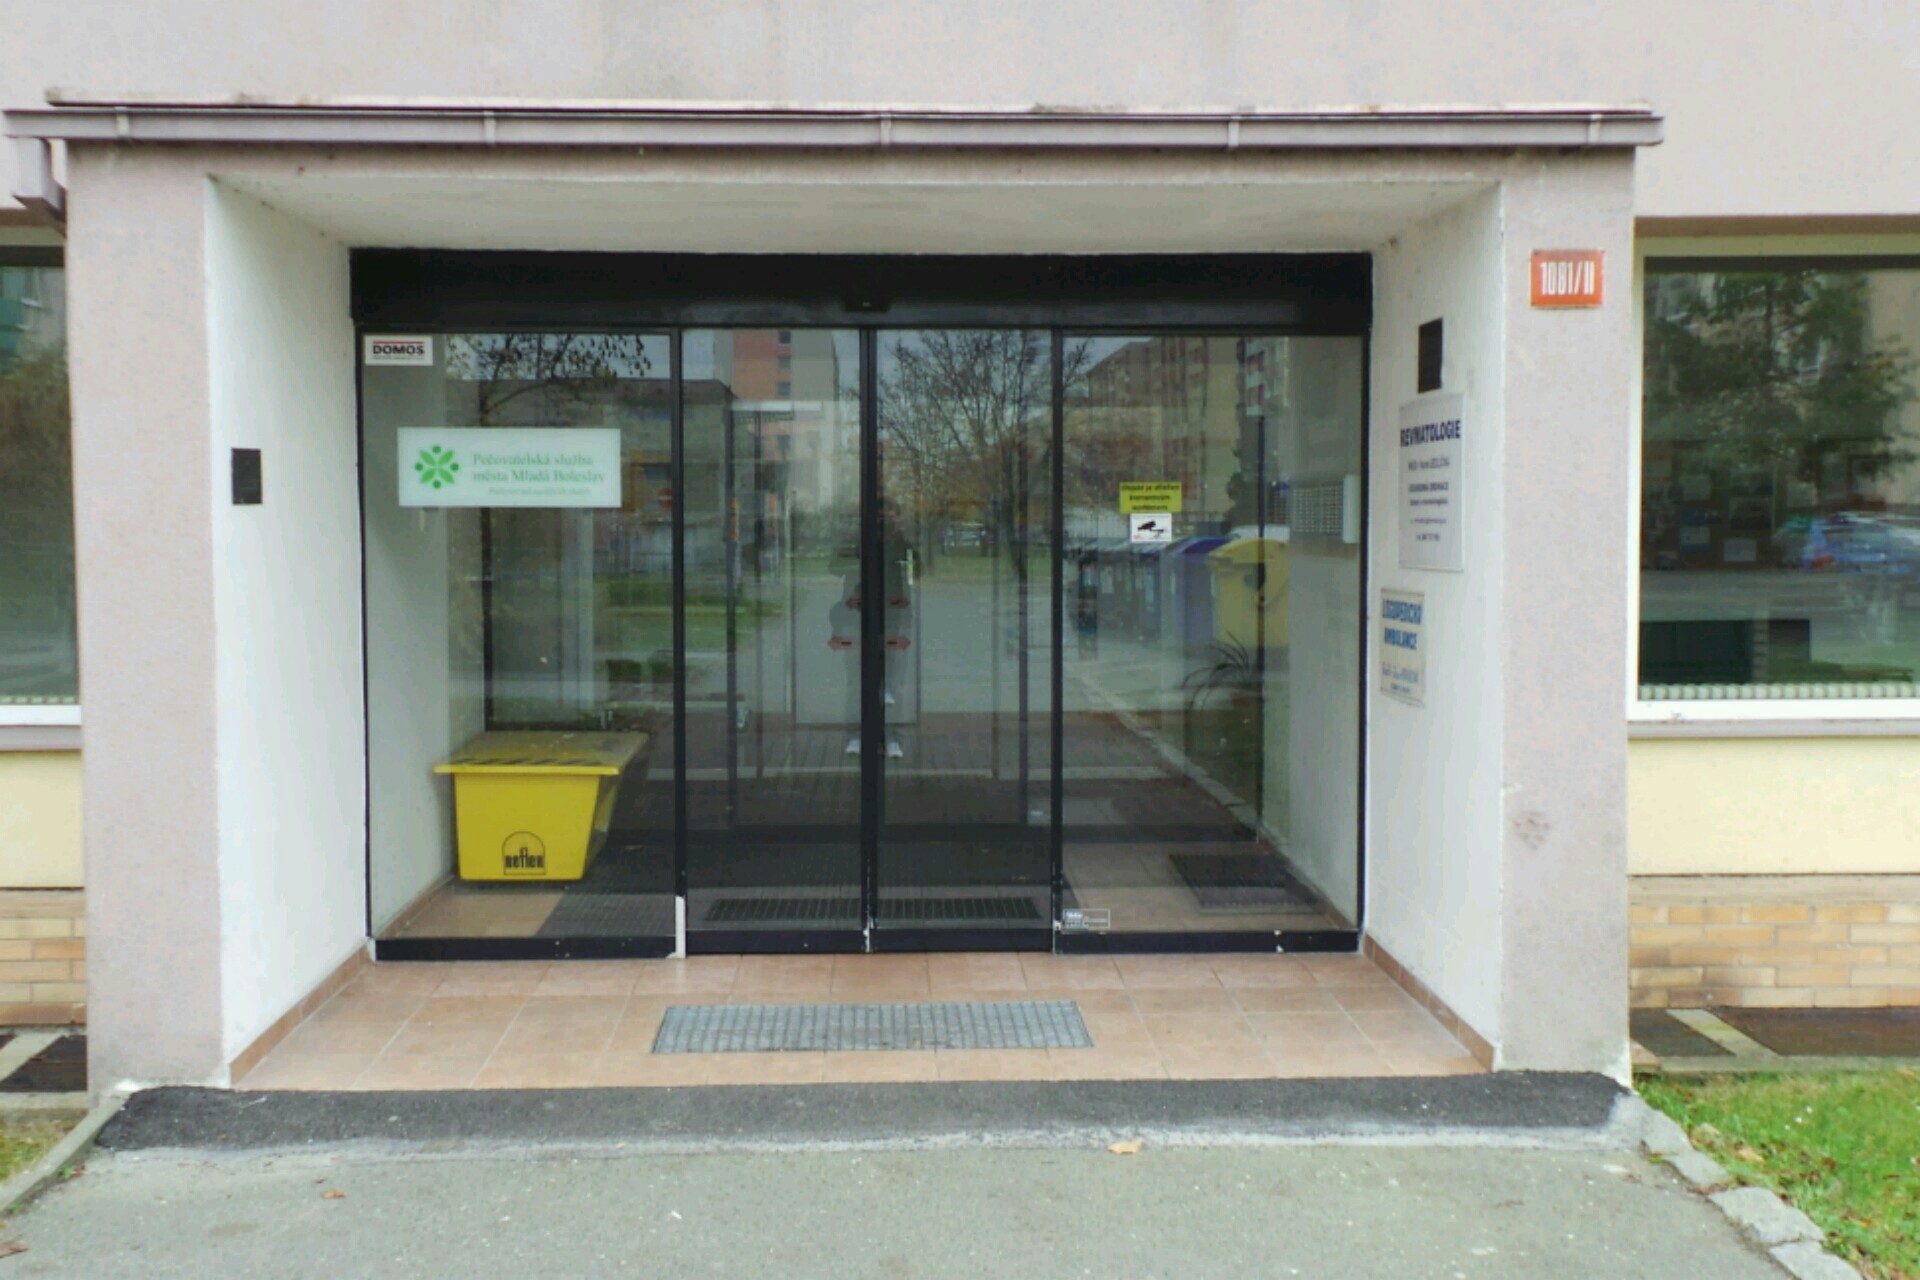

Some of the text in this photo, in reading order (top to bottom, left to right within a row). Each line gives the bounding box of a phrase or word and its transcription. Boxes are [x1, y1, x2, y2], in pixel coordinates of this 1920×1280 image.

[1540, 261, 1595, 296] 1081/II
[373, 345, 425, 355] DOMOS
[511, 469, 550, 481] Mladá
[554, 469, 605, 482] Boleslav
